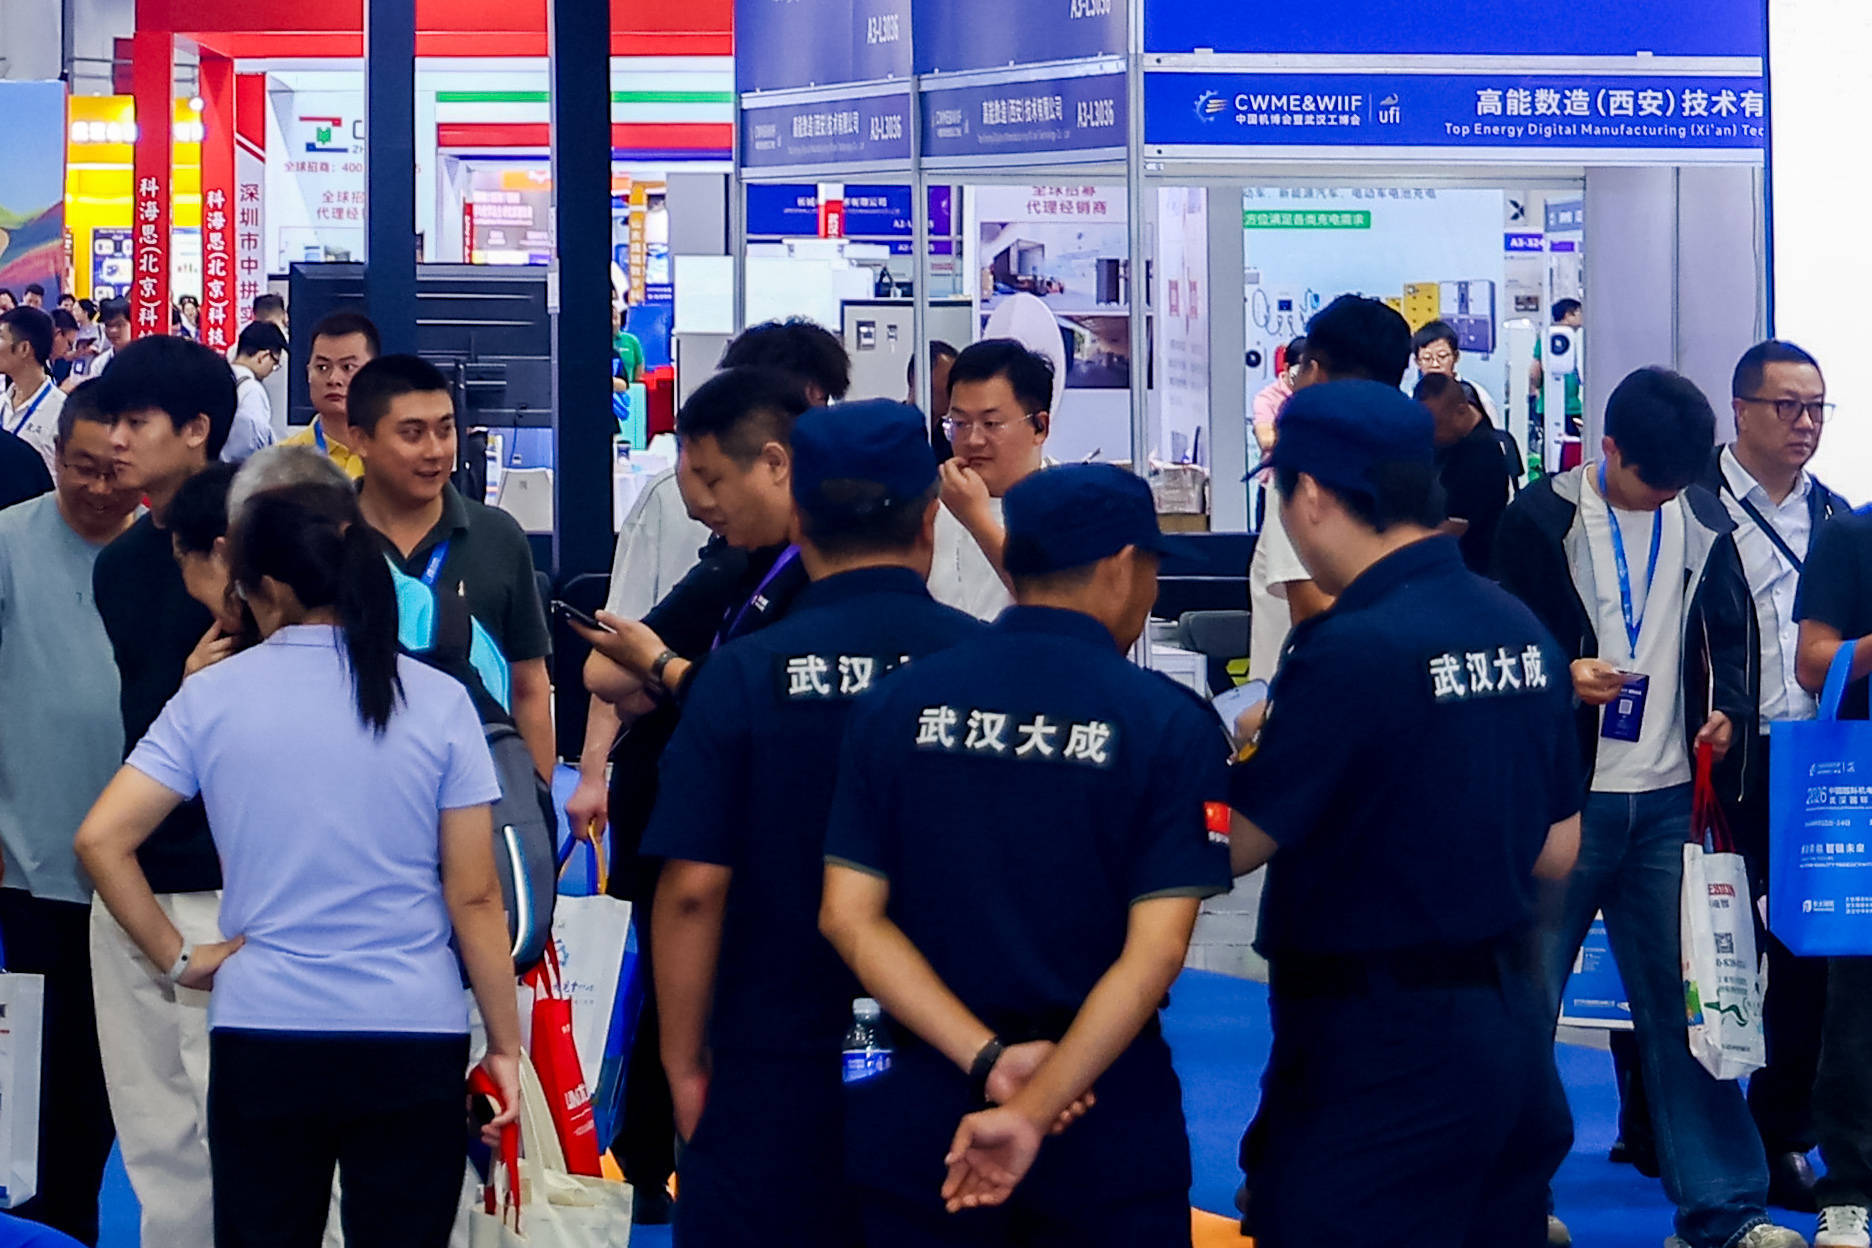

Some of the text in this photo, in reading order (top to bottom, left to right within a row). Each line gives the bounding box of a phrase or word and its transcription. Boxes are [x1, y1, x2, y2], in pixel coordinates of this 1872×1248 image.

[1234, 93, 1363, 112] CWME&WIIF
[1378, 106, 1401, 124] ufi
[1444, 123, 1470, 138] Top
[1474, 123, 1525, 138] Energy
[1527, 123, 1577, 138] Digital
[1581, 123, 1687, 139] Manufacturing
[1429, 644, 1547, 697] 武汉大成
[916, 705, 1111, 765] 武汉大成
